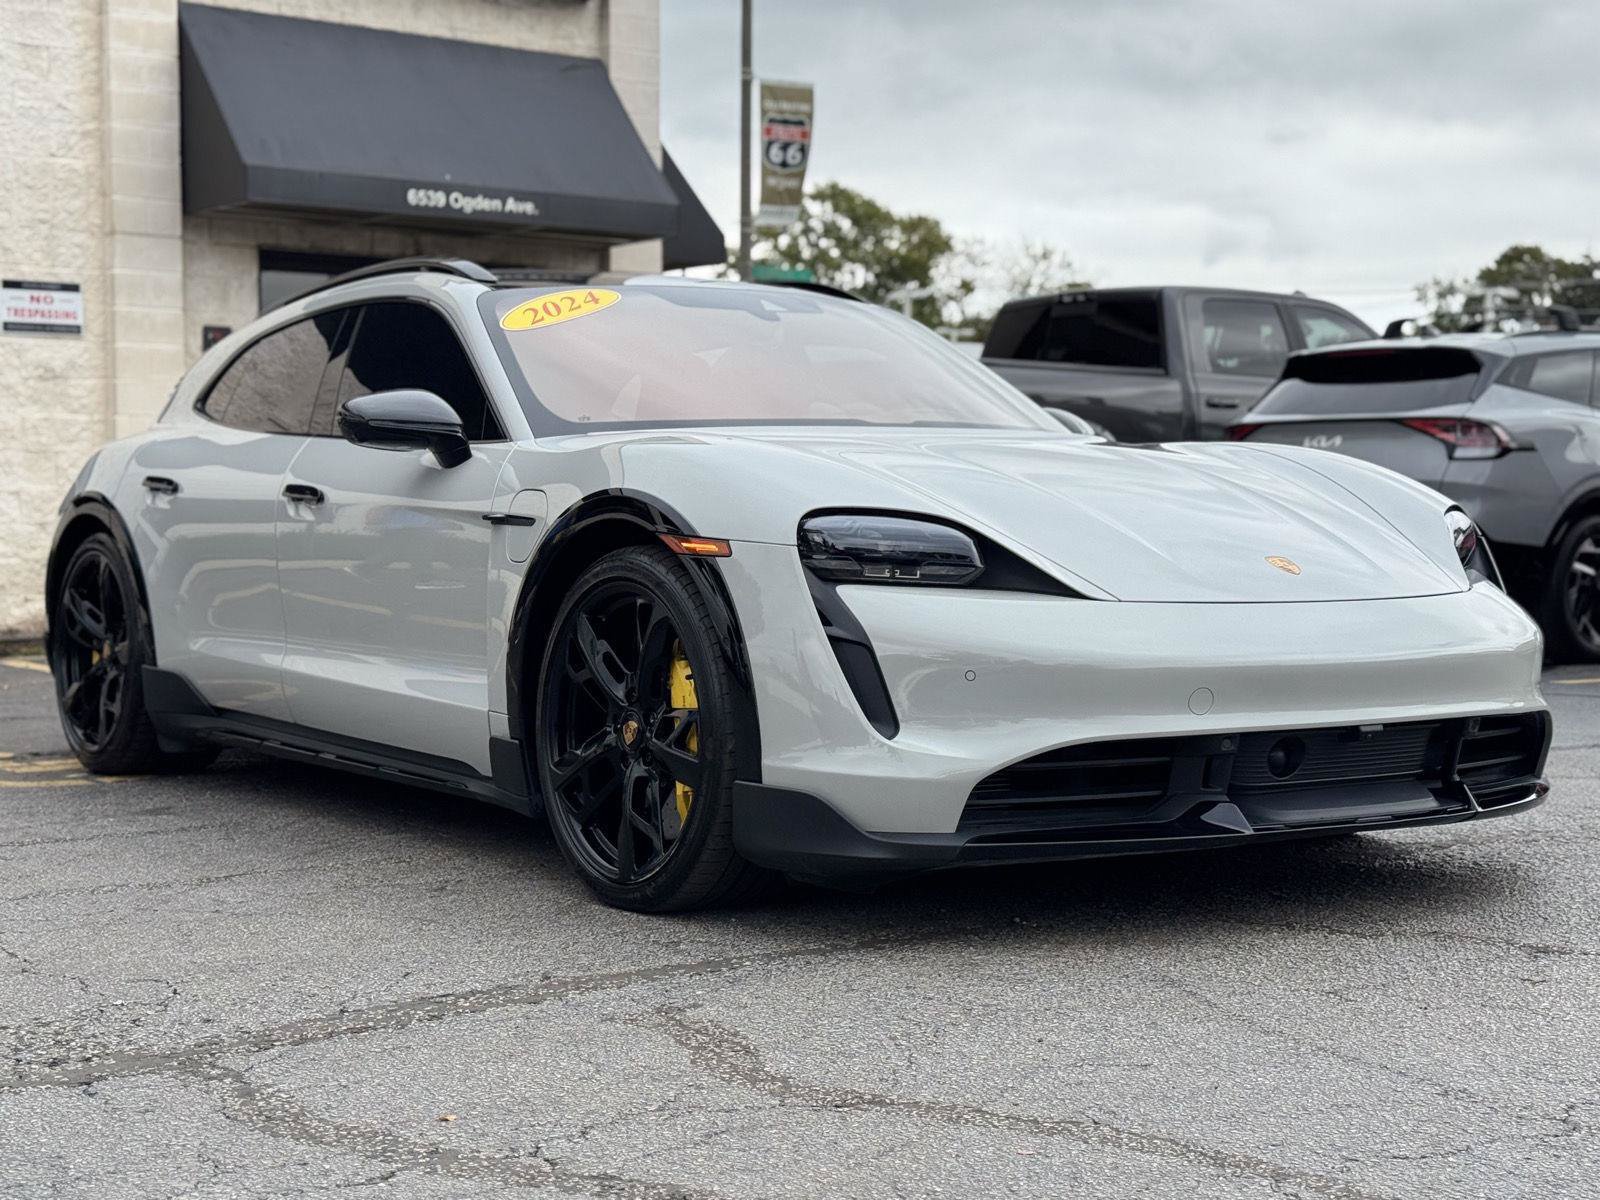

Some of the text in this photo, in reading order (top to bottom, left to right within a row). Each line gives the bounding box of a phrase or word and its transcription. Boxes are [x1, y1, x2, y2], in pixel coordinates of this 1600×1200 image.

[768, 141, 804, 166] 66
[406, 187, 539, 216] 6539 Ogden Ave.
[30, 294, 55, 305] NO
[522, 290, 601, 326] 2024
[7, 307, 79, 320] TRESPASSING
